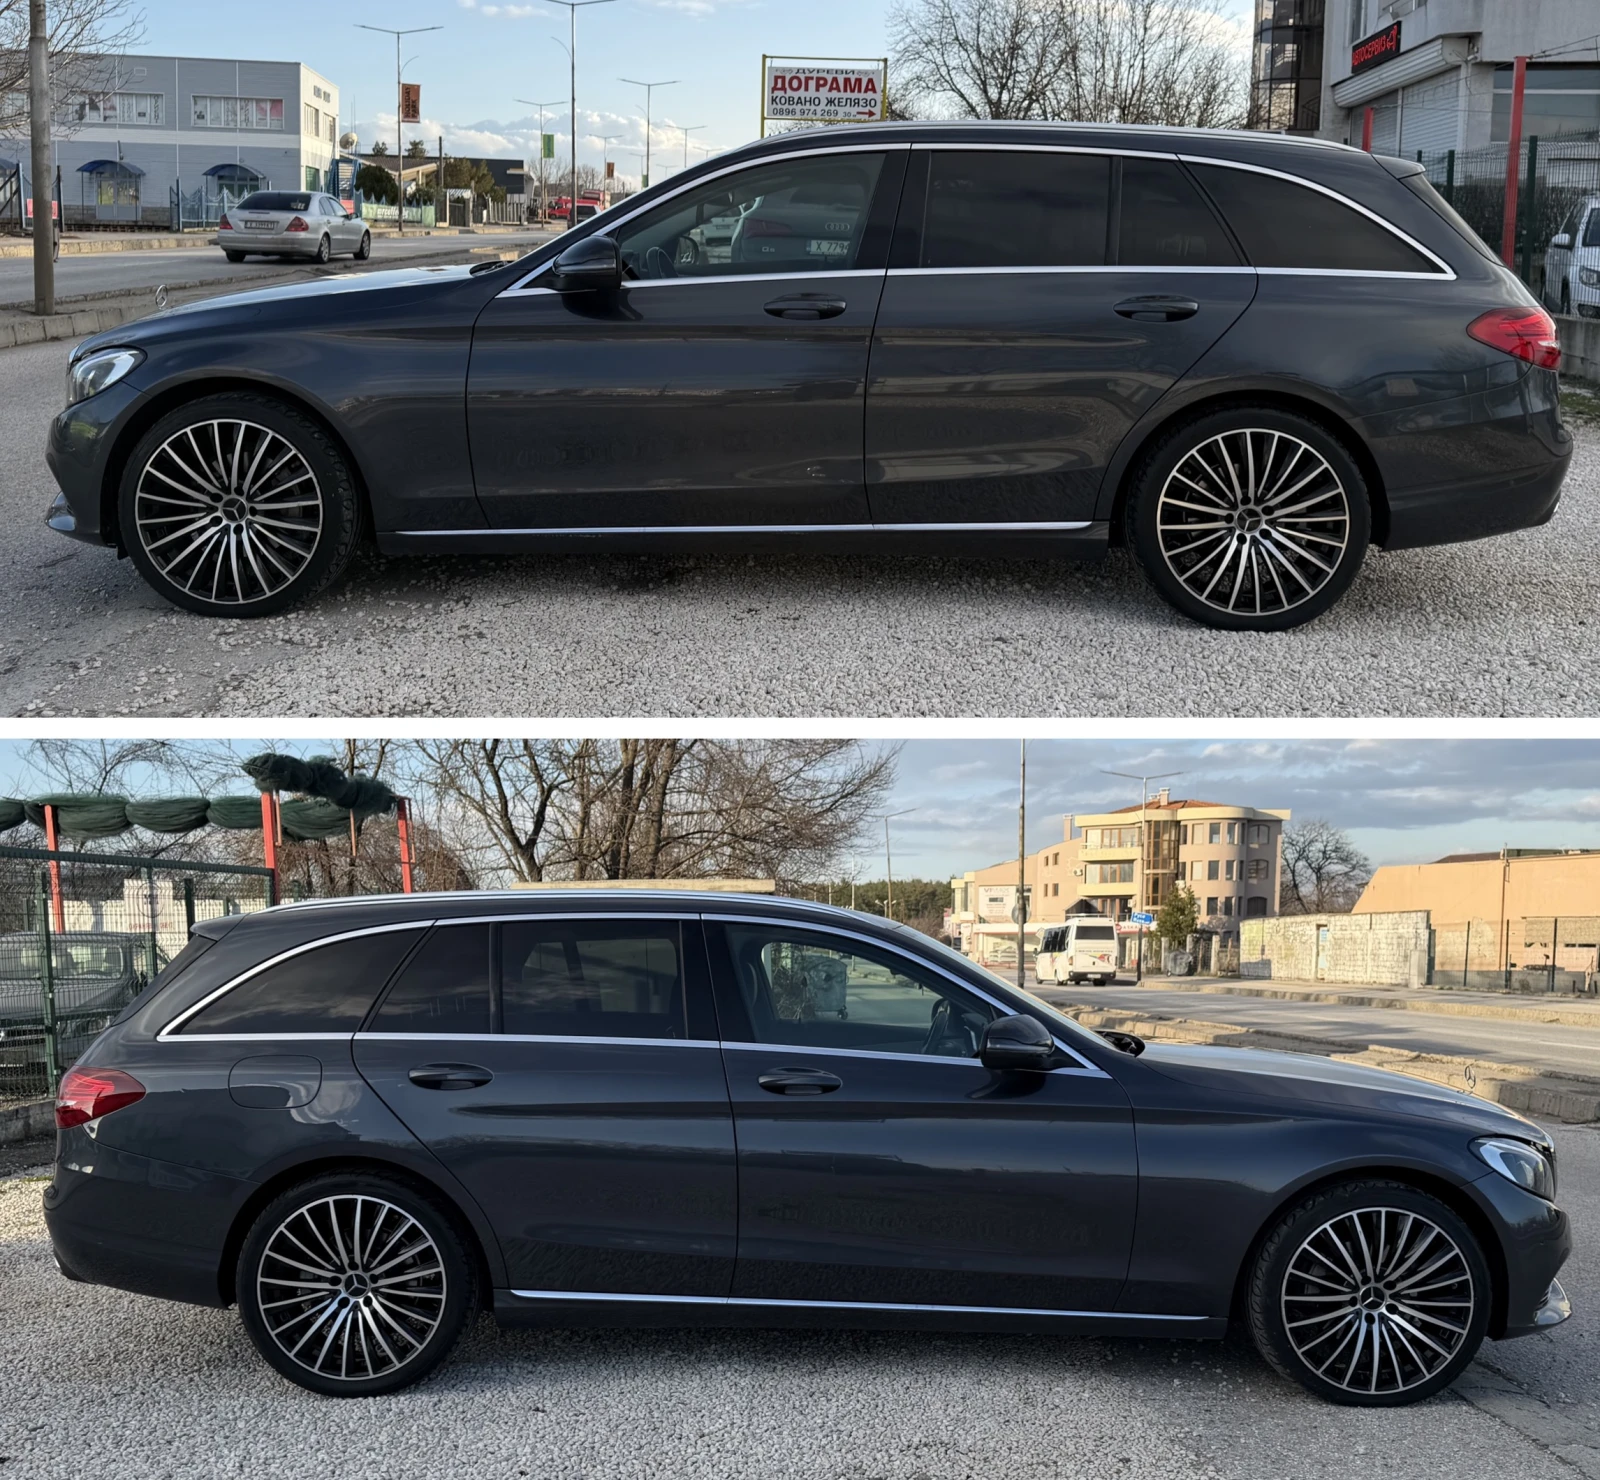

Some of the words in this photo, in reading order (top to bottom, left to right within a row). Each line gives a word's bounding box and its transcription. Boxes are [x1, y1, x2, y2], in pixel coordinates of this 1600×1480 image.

[795, 68, 855, 76] ДУРЕВИ
[771, 75, 877, 94] ДОГРАМА
[771, 95, 821, 107] КОВАНО
[825, 96, 877, 108] ЖЕЛЯЗО
[772, 107, 796, 116] 0896
[799, 108, 818, 116] 974
[820, 109, 838, 117] 269
